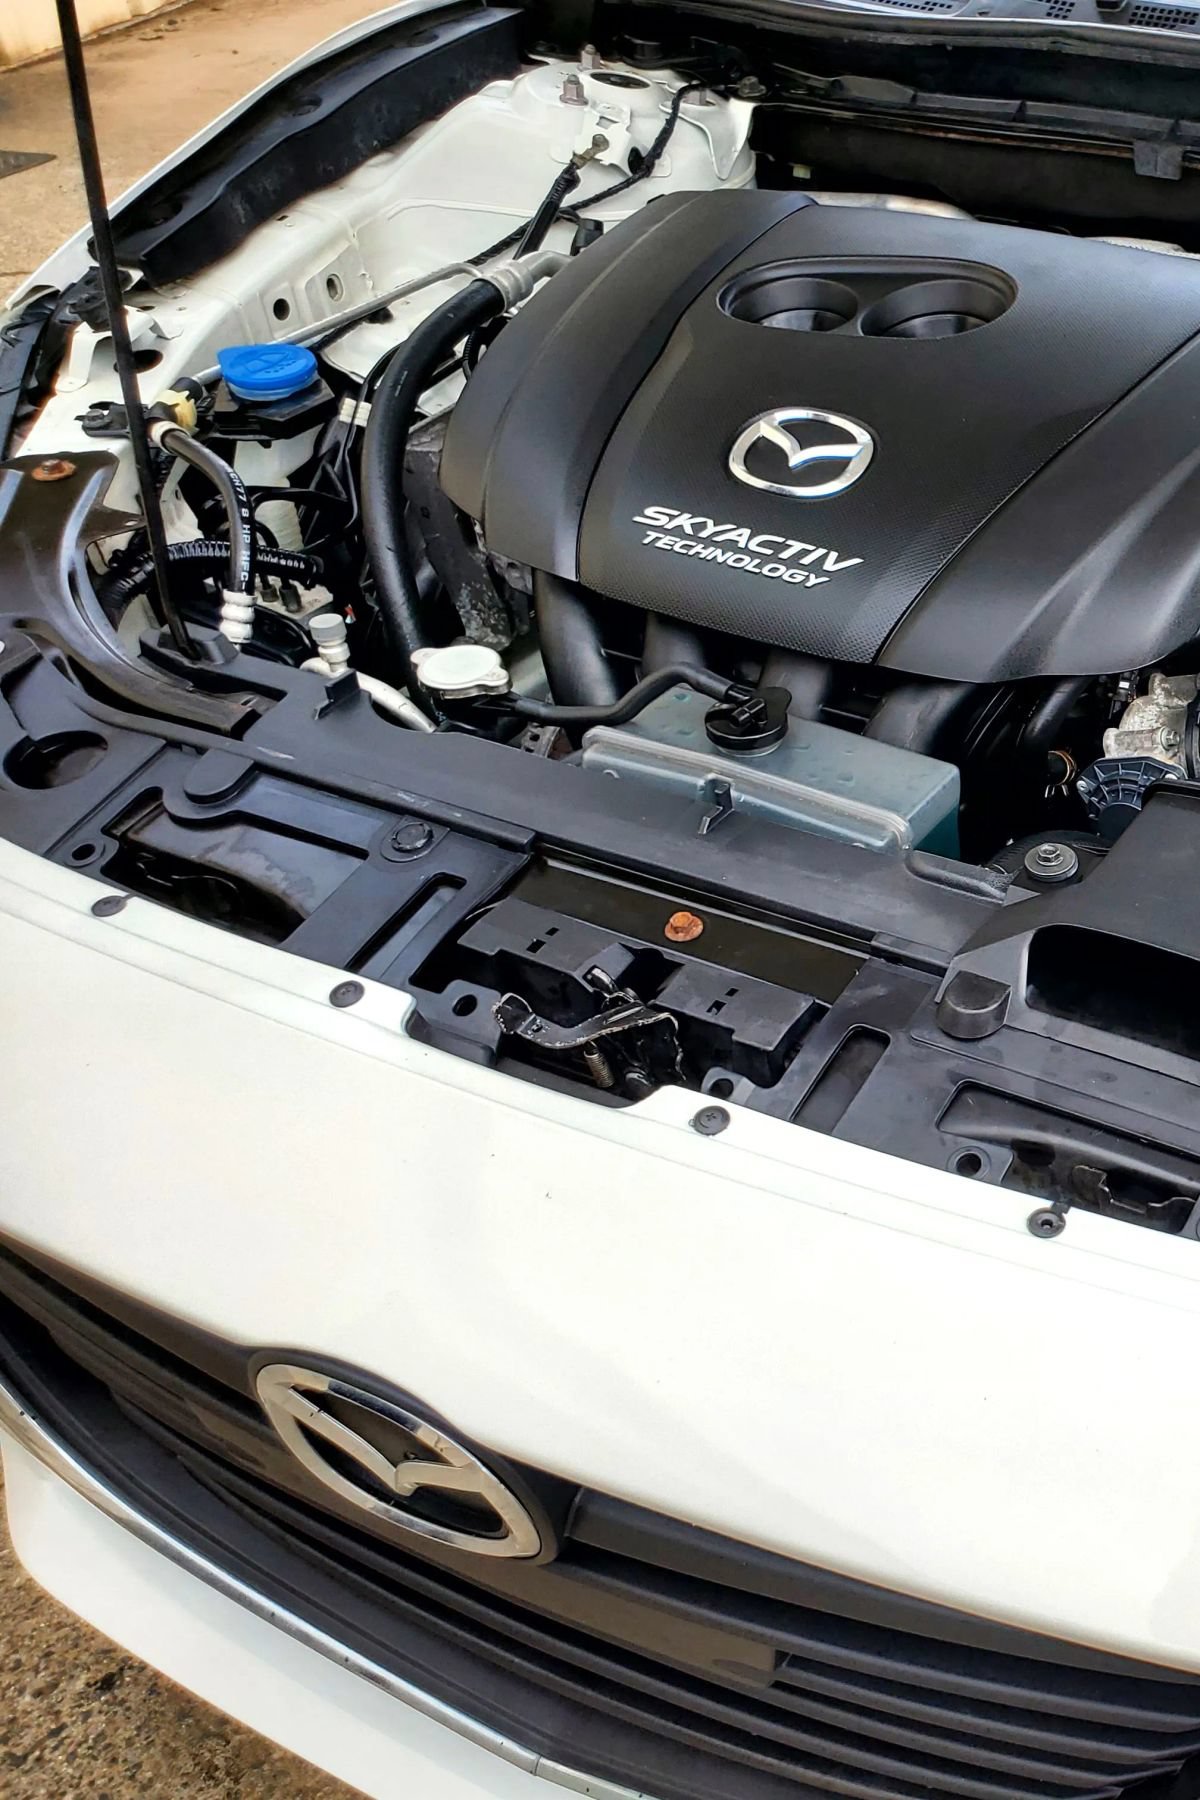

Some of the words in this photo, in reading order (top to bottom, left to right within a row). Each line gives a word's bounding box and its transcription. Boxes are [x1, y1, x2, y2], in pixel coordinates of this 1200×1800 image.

[242, 524, 251, 543] HP
[632, 506, 864, 573] SKYACTIV
[641, 530, 831, 589] TECHNOLOGY
